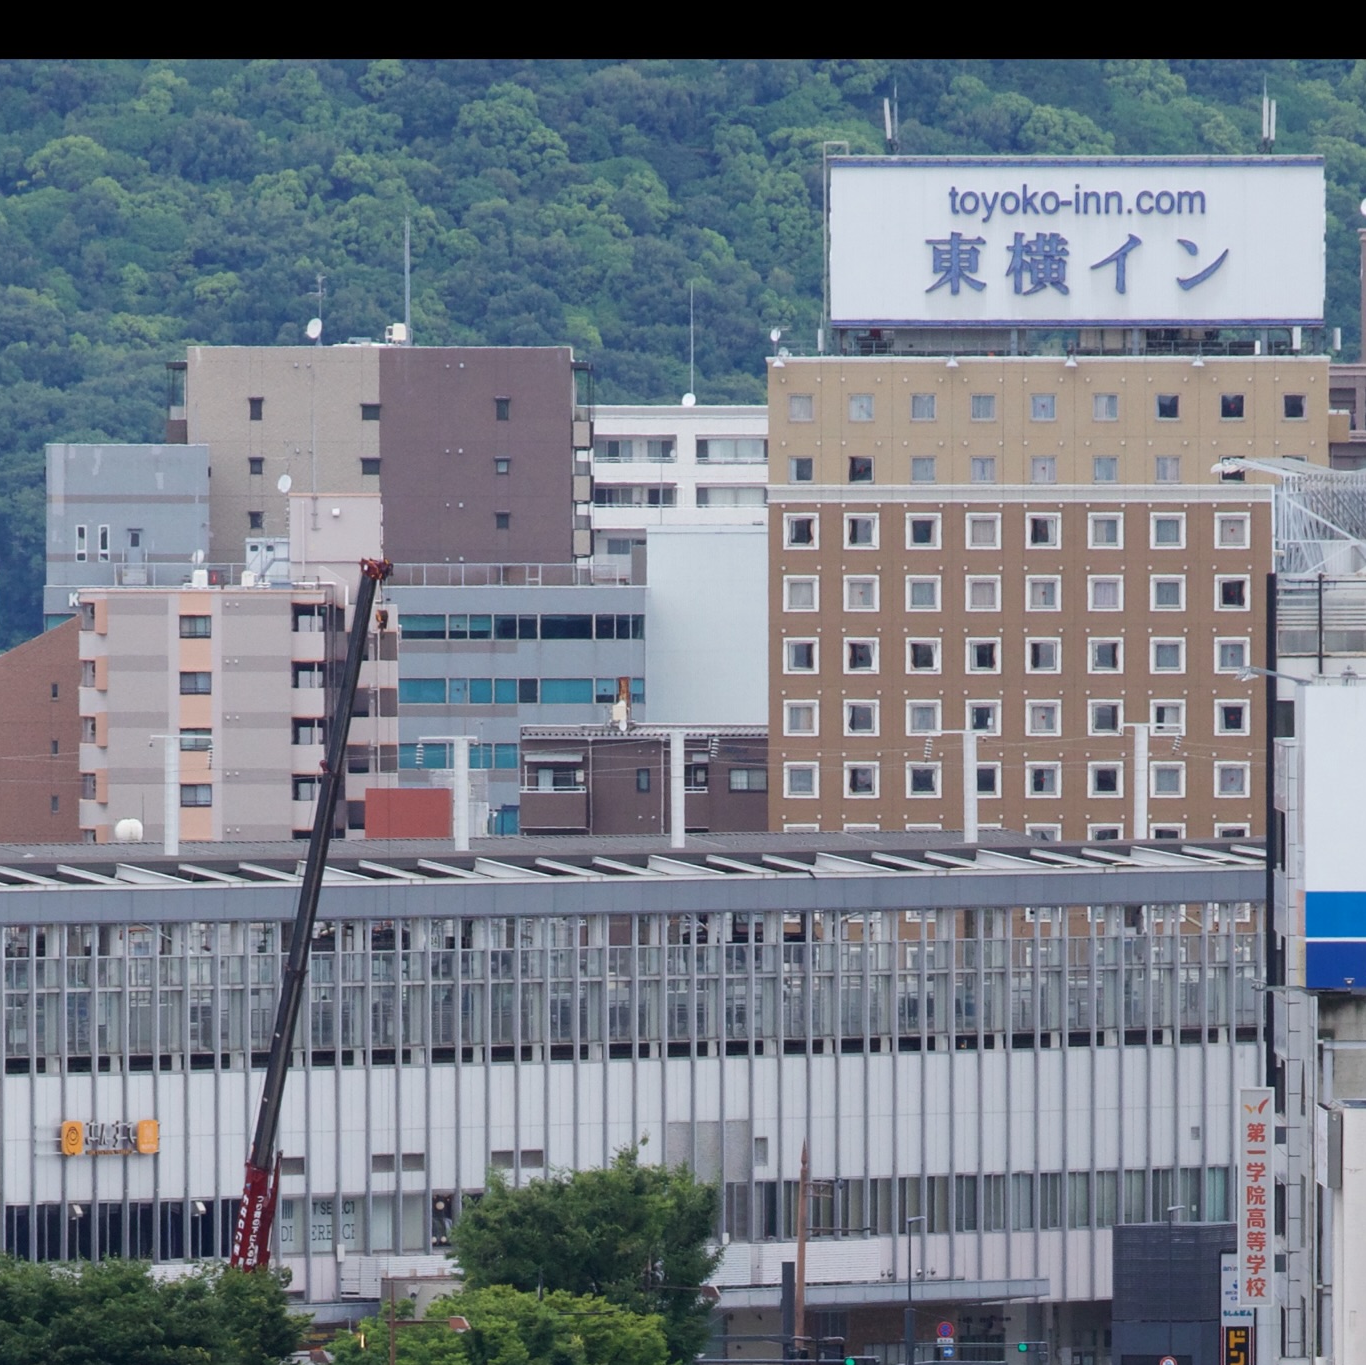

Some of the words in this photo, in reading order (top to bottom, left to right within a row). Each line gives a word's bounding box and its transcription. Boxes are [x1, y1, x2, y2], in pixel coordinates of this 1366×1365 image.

[949, 184, 1206, 223] toyoko-inn.com
[925, 231, 1231, 297] 東横イン
[1246, 1123, 1267, 1297] 第一学院高等学校
